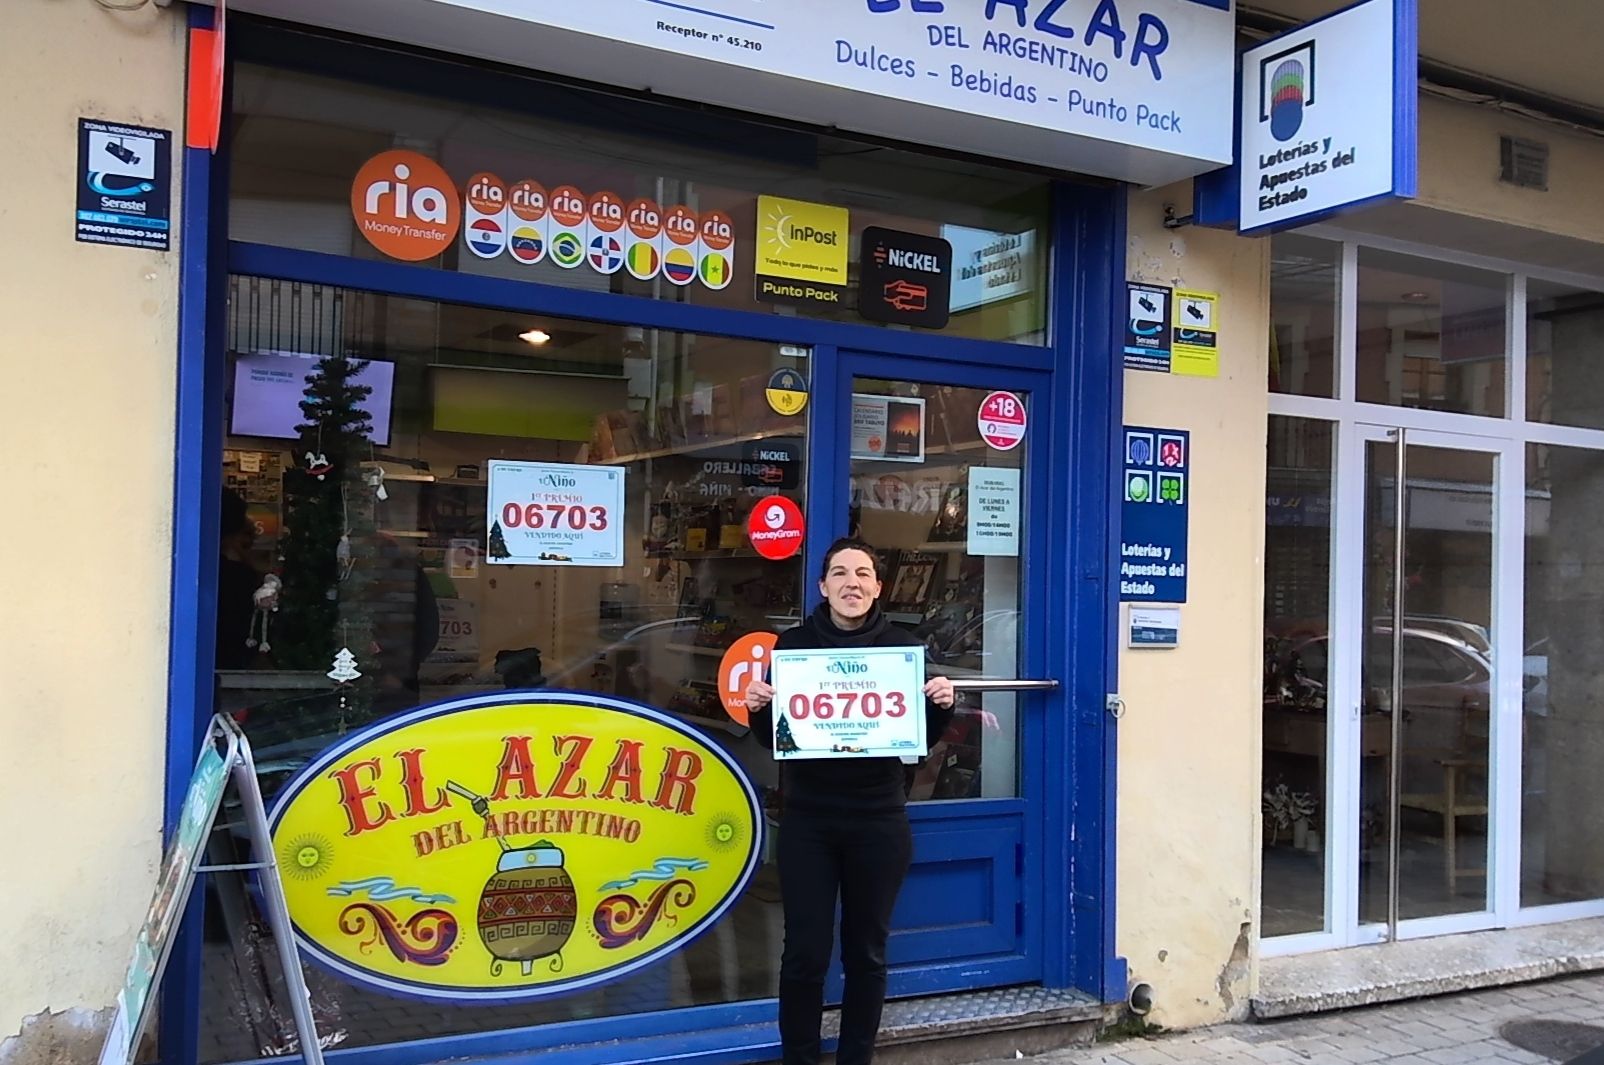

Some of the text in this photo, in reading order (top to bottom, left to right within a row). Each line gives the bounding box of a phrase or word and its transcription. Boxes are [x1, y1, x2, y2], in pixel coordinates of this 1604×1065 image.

[656, 21, 708, 39] Receptor
[726, 36, 762, 52] 45.210
[927, 25, 1108, 83] DEL ARGENTINO
[835, 40, 915, 78] Dulces
[950, 64, 1037, 104] Bebidas
[1068, 89, 1127, 123] Punto
[1136, 104, 1181, 133] Pack
[84, 122, 106, 131] ZONA
[1259, 137, 1332, 169] Loterías y
[1259, 147, 1355, 190] Apuestas del
[365, 163, 448, 225] ria
[471, 177, 502, 202] ria
[513, 184, 544, 209] ria
[1259, 186, 1308, 211] Estado
[101, 196, 146, 211] Serastel
[553, 190, 583, 214] ria
[592, 195, 622, 220] ria
[630, 203, 659, 227] ria
[668, 210, 695, 233] ria
[703, 215, 731, 239] ria
[364, 219, 447, 241] Money Transfer
[790, 224, 837, 246] InPost
[763, 282, 839, 302] Punto Pack
[989, 397, 1015, 418] +18
[544, 493, 582, 503] PREMIO
[502, 502, 608, 531] 06703
[525, 531, 562, 540] VENDIDO
[751, 529, 801, 541] MoneyGram
[1121, 543, 1171, 560] Loterías y
[1121, 562, 1184, 578] Apuestas del
[1121, 581, 1155, 595] Estado
[440, 621, 473, 635] 703
[728, 645, 768, 692] ri
[832, 680, 877, 691] PREMIO
[728, 697, 746, 707] Mon
[789, 691, 907, 720] 06703
[813, 722, 855, 730] VENDIDO
[327, 734, 704, 838] EL AZAR
[412, 809, 643, 859] DEL ARGENTINO
